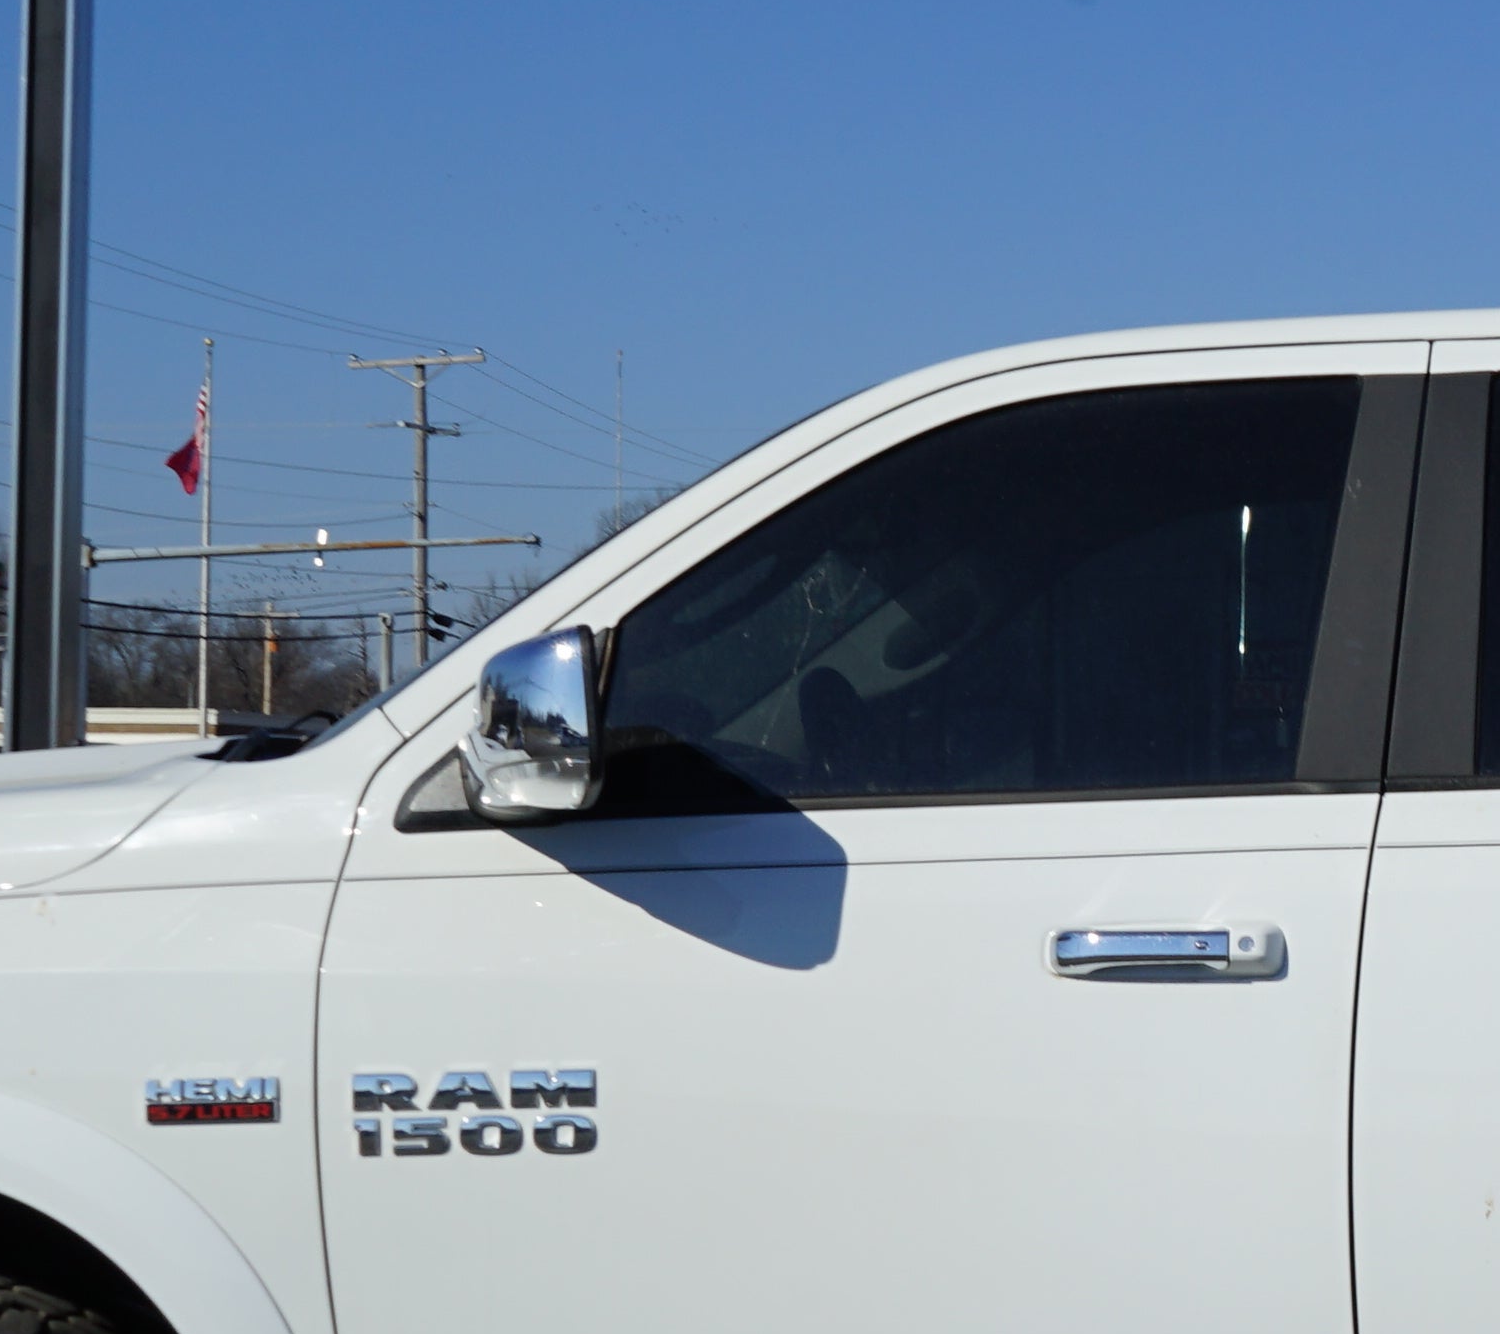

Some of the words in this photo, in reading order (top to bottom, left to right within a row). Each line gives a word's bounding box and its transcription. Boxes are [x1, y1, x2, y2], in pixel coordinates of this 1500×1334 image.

[145, 1076, 279, 1103] HEMI
[352, 1069, 598, 1112] RAM
[195, 1103, 272, 1120] LITER
[353, 1114, 598, 1157] 1500
